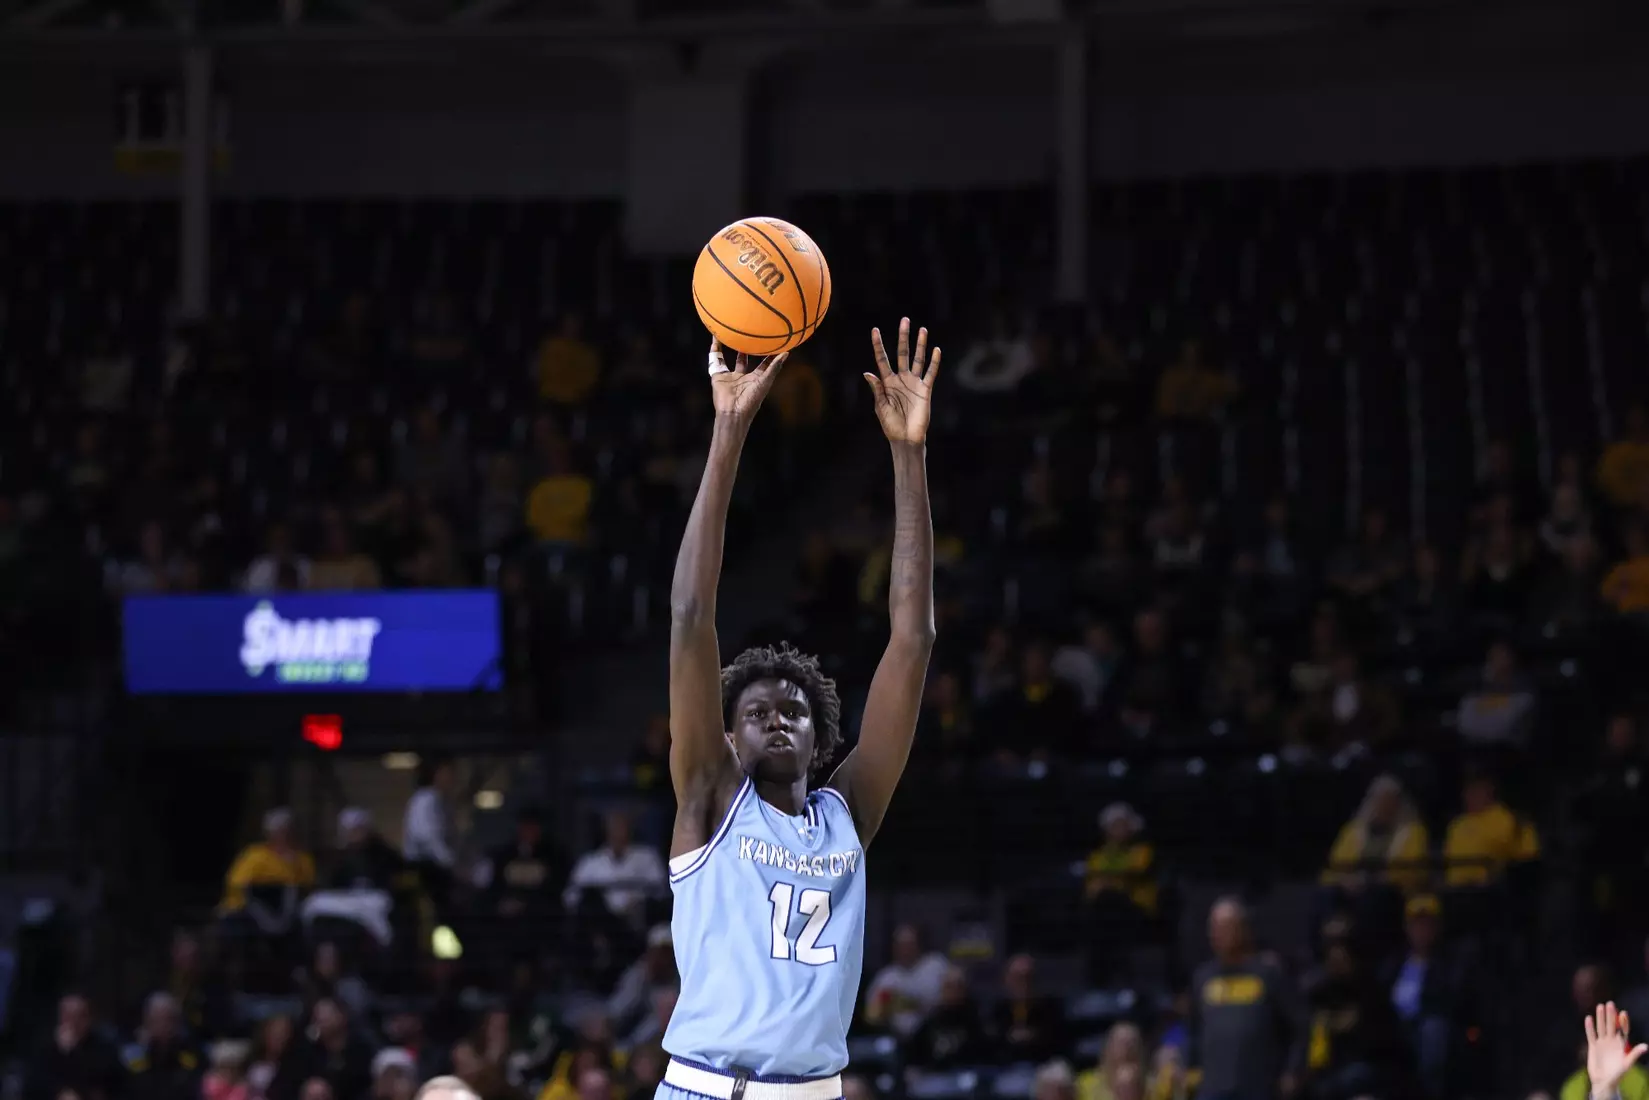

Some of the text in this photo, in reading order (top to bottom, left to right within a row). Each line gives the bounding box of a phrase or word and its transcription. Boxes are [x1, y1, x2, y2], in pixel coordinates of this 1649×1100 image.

[721, 227, 785, 296] Wilson
[738, 835, 825, 877] KANSAS
[768, 881, 837, 967] 12
